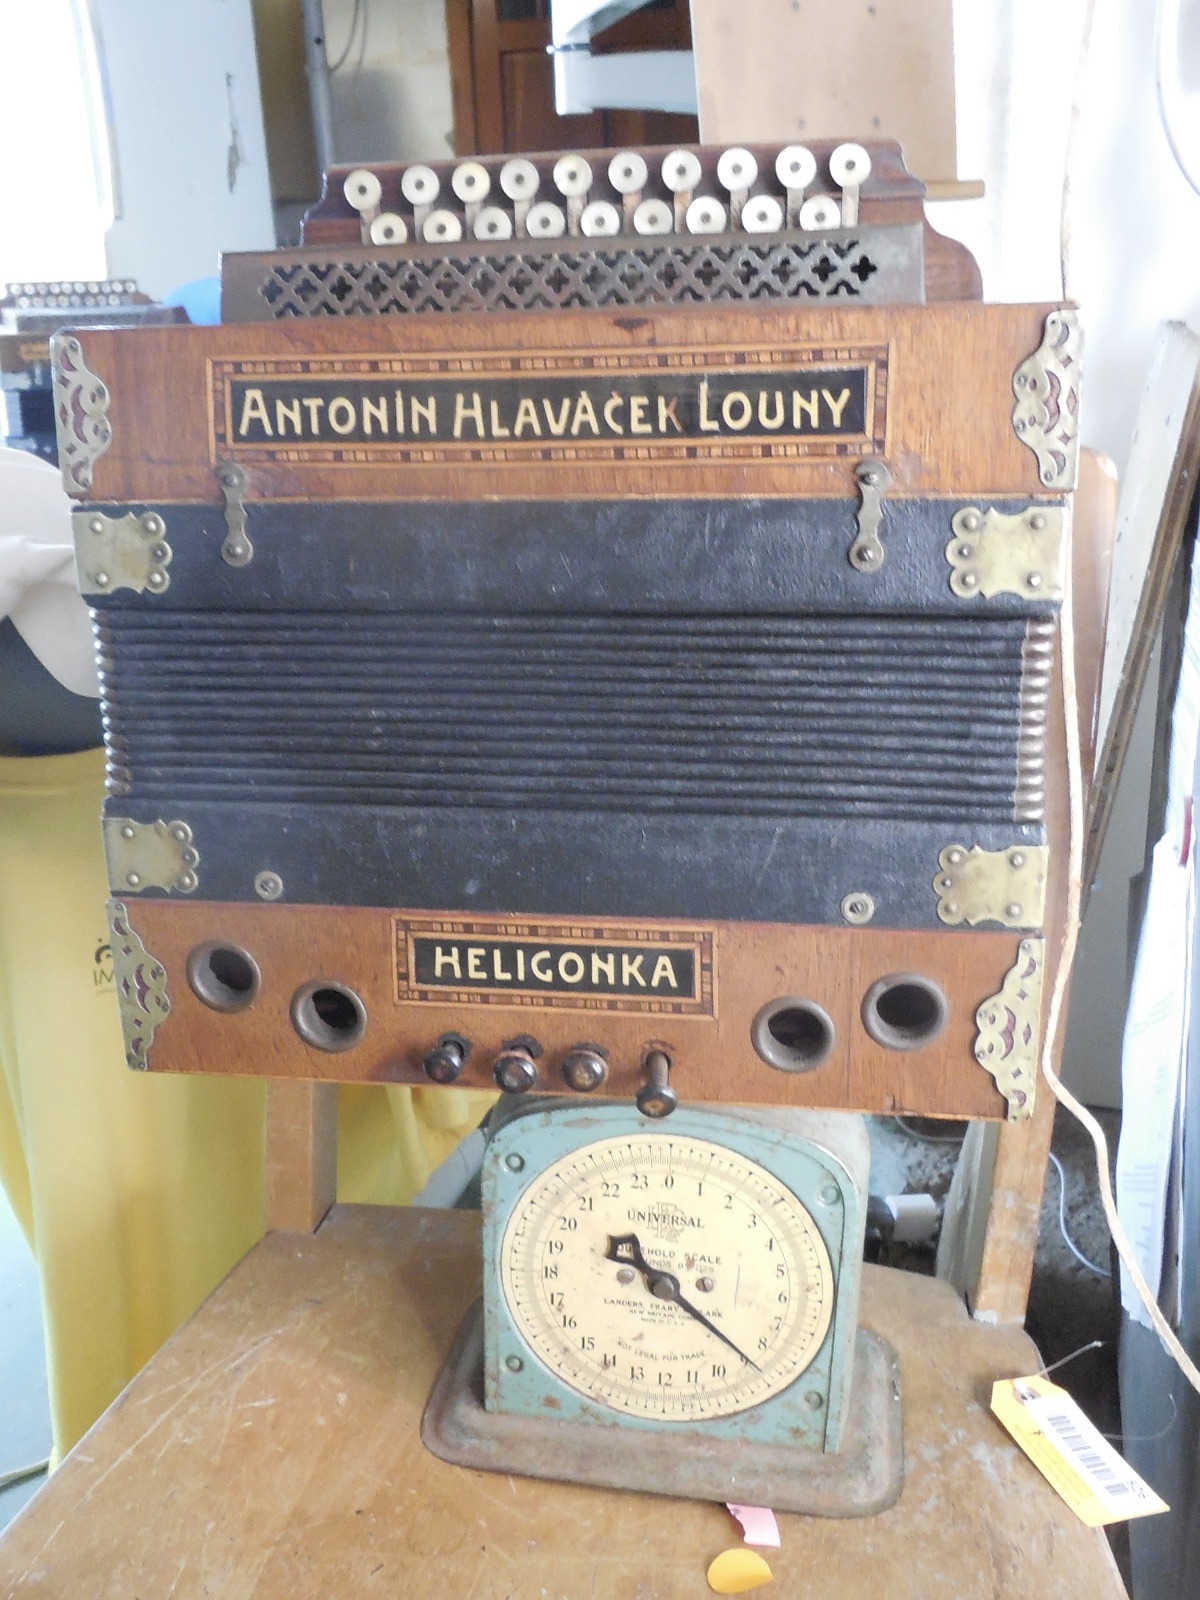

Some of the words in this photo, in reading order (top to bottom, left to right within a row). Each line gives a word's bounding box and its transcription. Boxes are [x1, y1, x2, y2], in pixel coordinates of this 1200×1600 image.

[699, 375, 850, 431] LOUNY
[434, 946, 678, 989] HELIGONKA
[631, 1173, 648, 1190] 23
[664, 1175, 674, 1189] 0
[601, 1182, 620, 1198] 22
[697, 1182, 703, 1197] 1
[579, 1196, 593, 1212] 21
[724, 1195, 733, 1210] 2
[559, 1216, 577, 1231] 20
[627, 1209, 705, 1229] UNIVERSAL
[747, 1213, 757, 1229] 3
[548, 1240, 564, 1255] 19
[685, 1252, 721, 1265] SCALE
[543, 1265, 558, 1280] 18
[776, 1264, 785, 1279] 5
[550, 1293, 565, 1309] 17
[778, 1291, 788, 1304] 6
[562, 1314, 577, 1330] 16
[773, 1316, 782, 1331] 7
[581, 1336, 595, 1351] 15
[758, 1337, 768, 1351] 8
[603, 1353, 617, 1368] 14
[662, 1354, 678, 1362] FOR
[681, 1350, 706, 1361] TRADE
[630, 1366, 645, 1380] 13
[687, 1370, 699, 1384] 11
[712, 1364, 727, 1378] 10
[658, 1372, 672, 1387] 12
